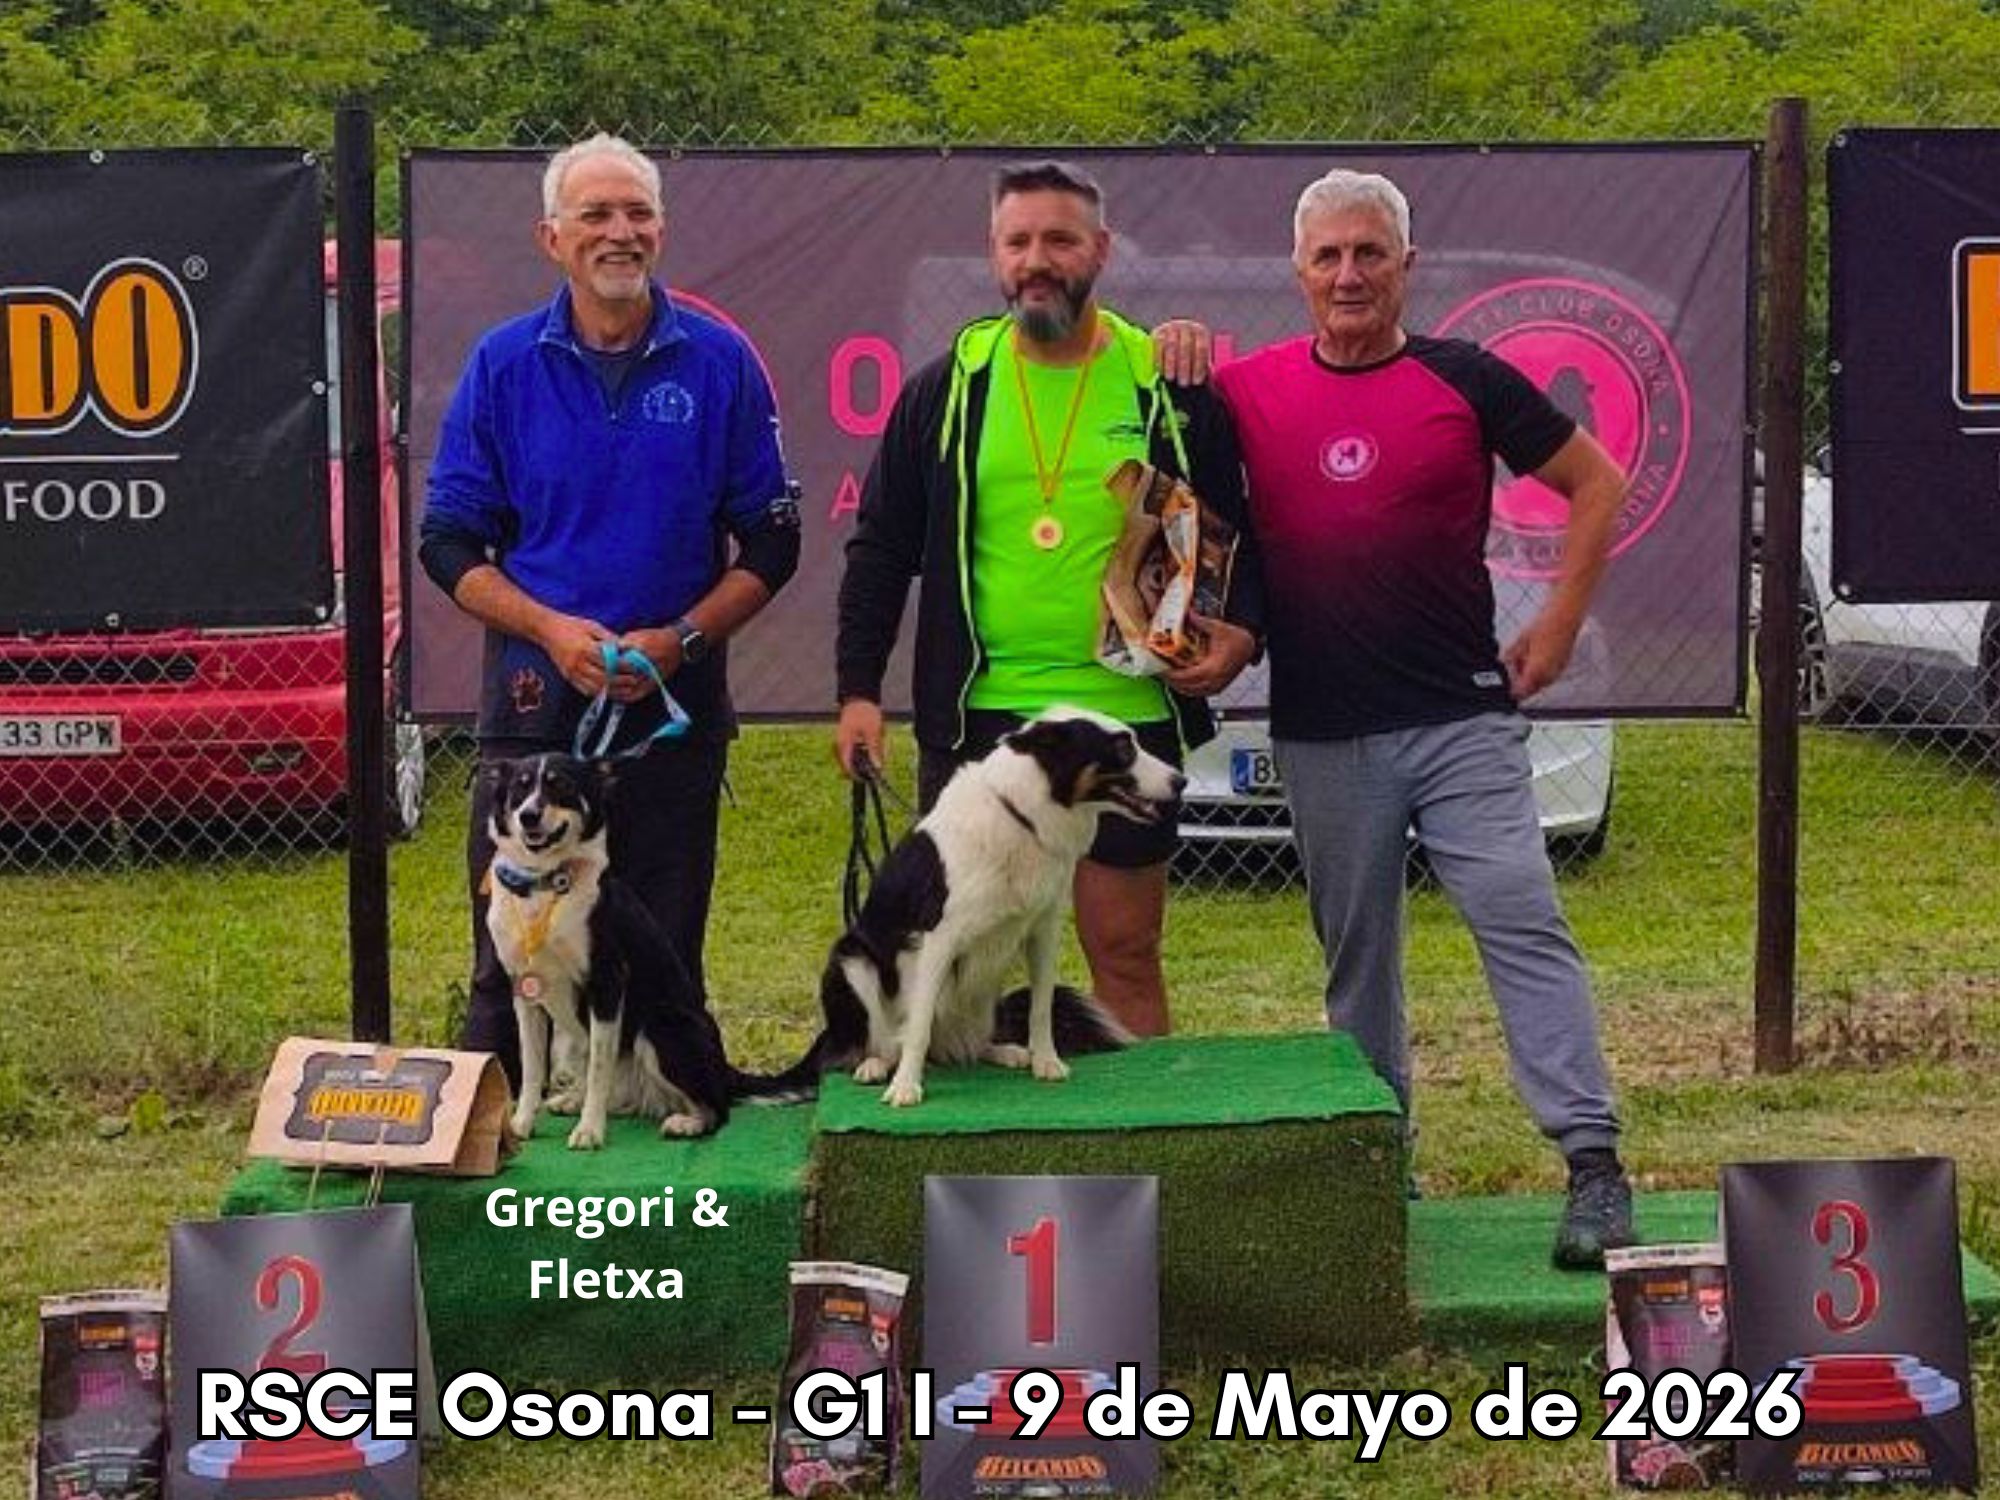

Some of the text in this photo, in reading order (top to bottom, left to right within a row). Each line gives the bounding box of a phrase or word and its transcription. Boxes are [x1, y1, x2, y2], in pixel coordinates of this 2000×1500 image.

[3, 478, 166, 522] FOOD
[256, 1253, 328, 1375] 2
[1006, 1215, 1060, 1347] 1
[1811, 1199, 1880, 1334] 3
